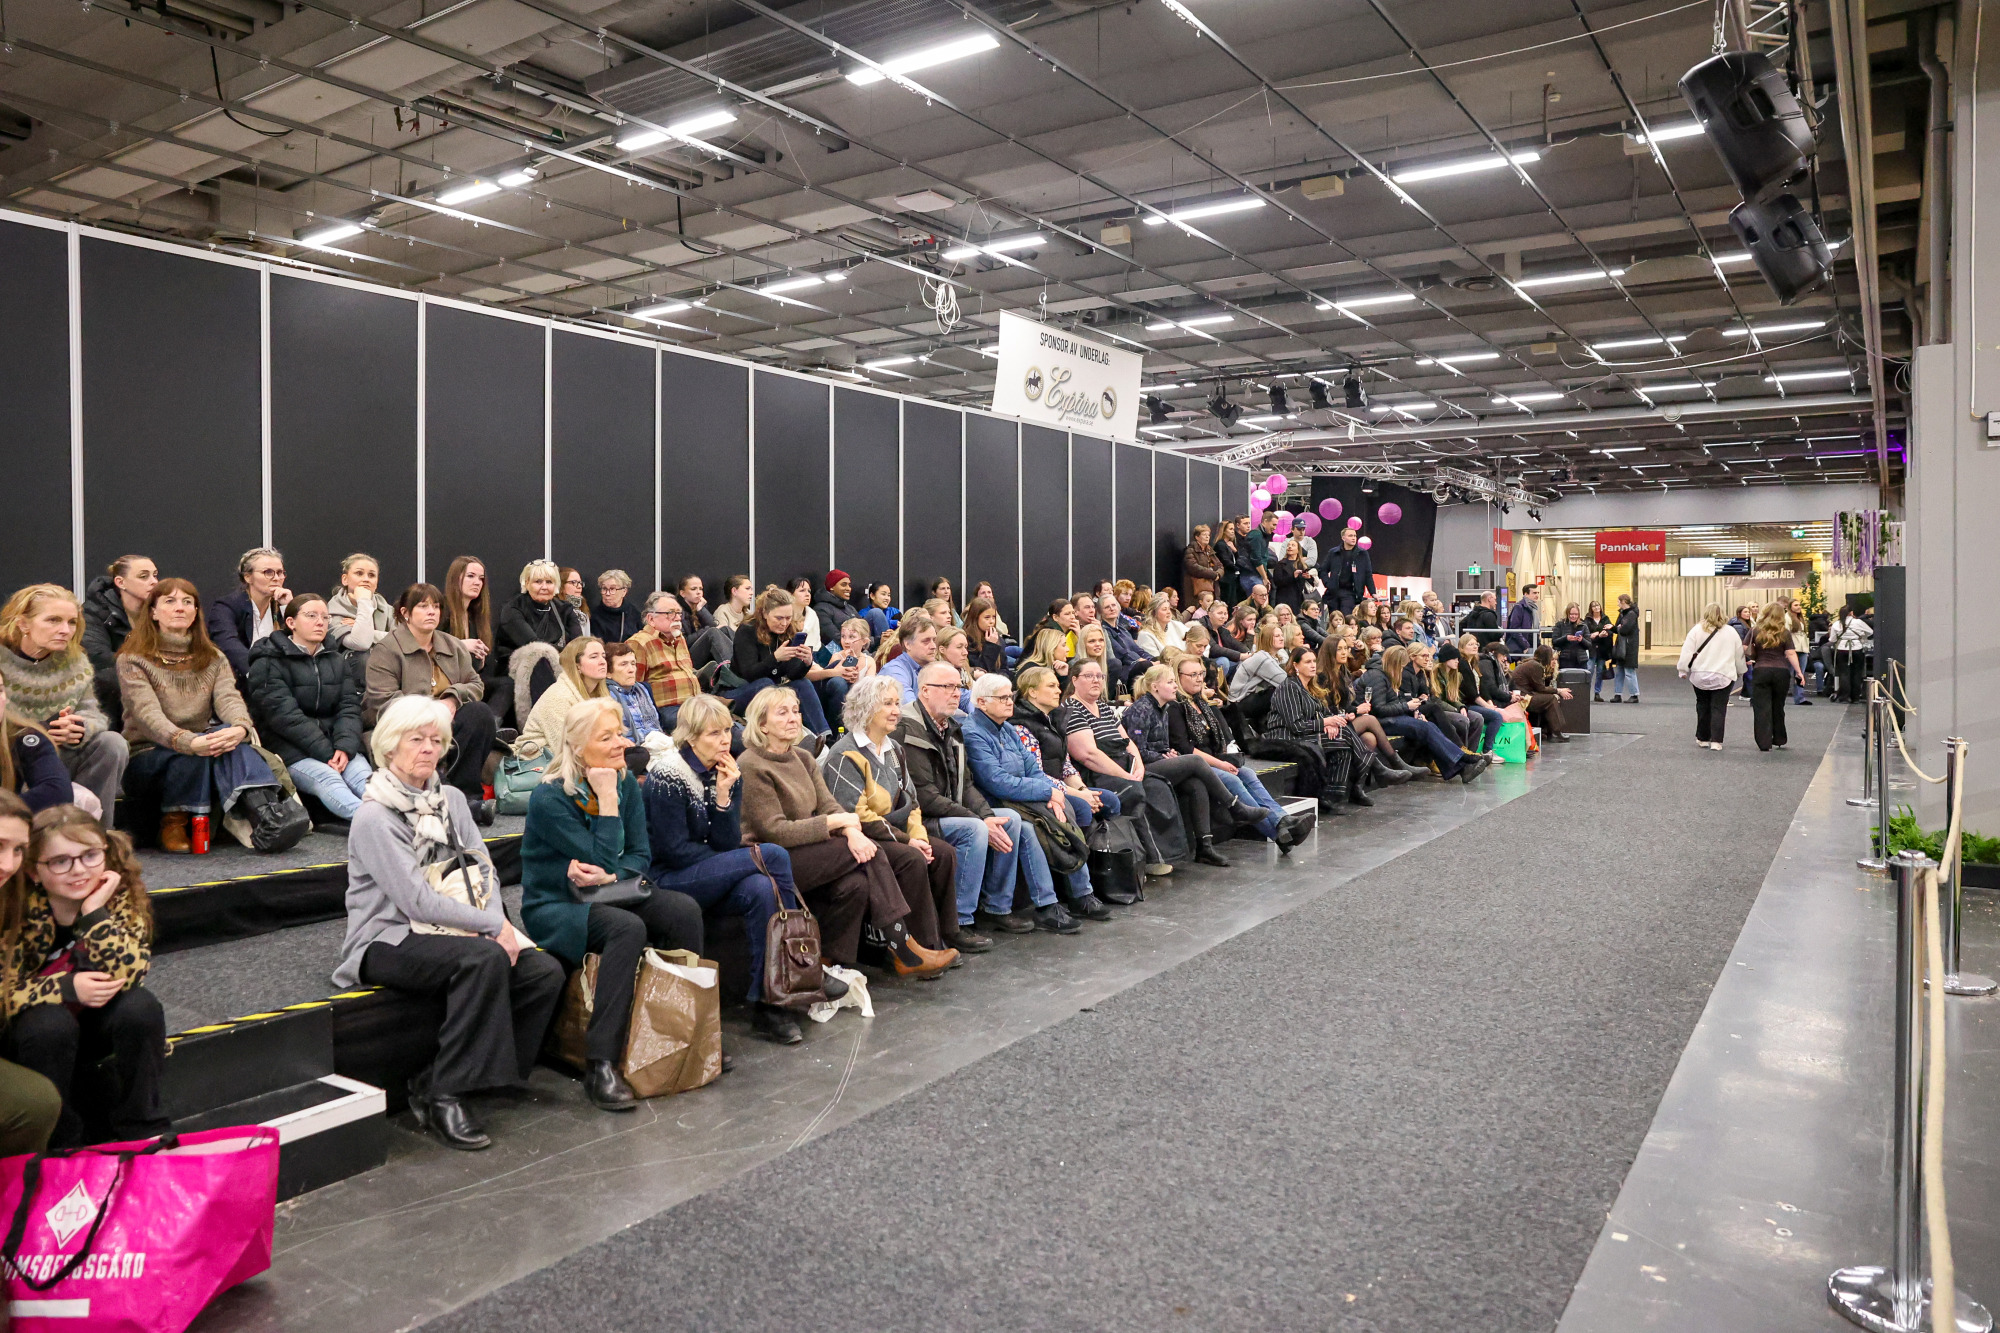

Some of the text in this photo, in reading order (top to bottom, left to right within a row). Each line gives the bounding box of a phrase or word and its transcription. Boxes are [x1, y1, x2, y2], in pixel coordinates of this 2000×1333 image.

[1039, 332, 1111, 366] SPONSOR AV UNDERLAG:
[1600, 542, 1660, 552] Pannkakor
[1779, 567, 1795, 579] ÅTER
